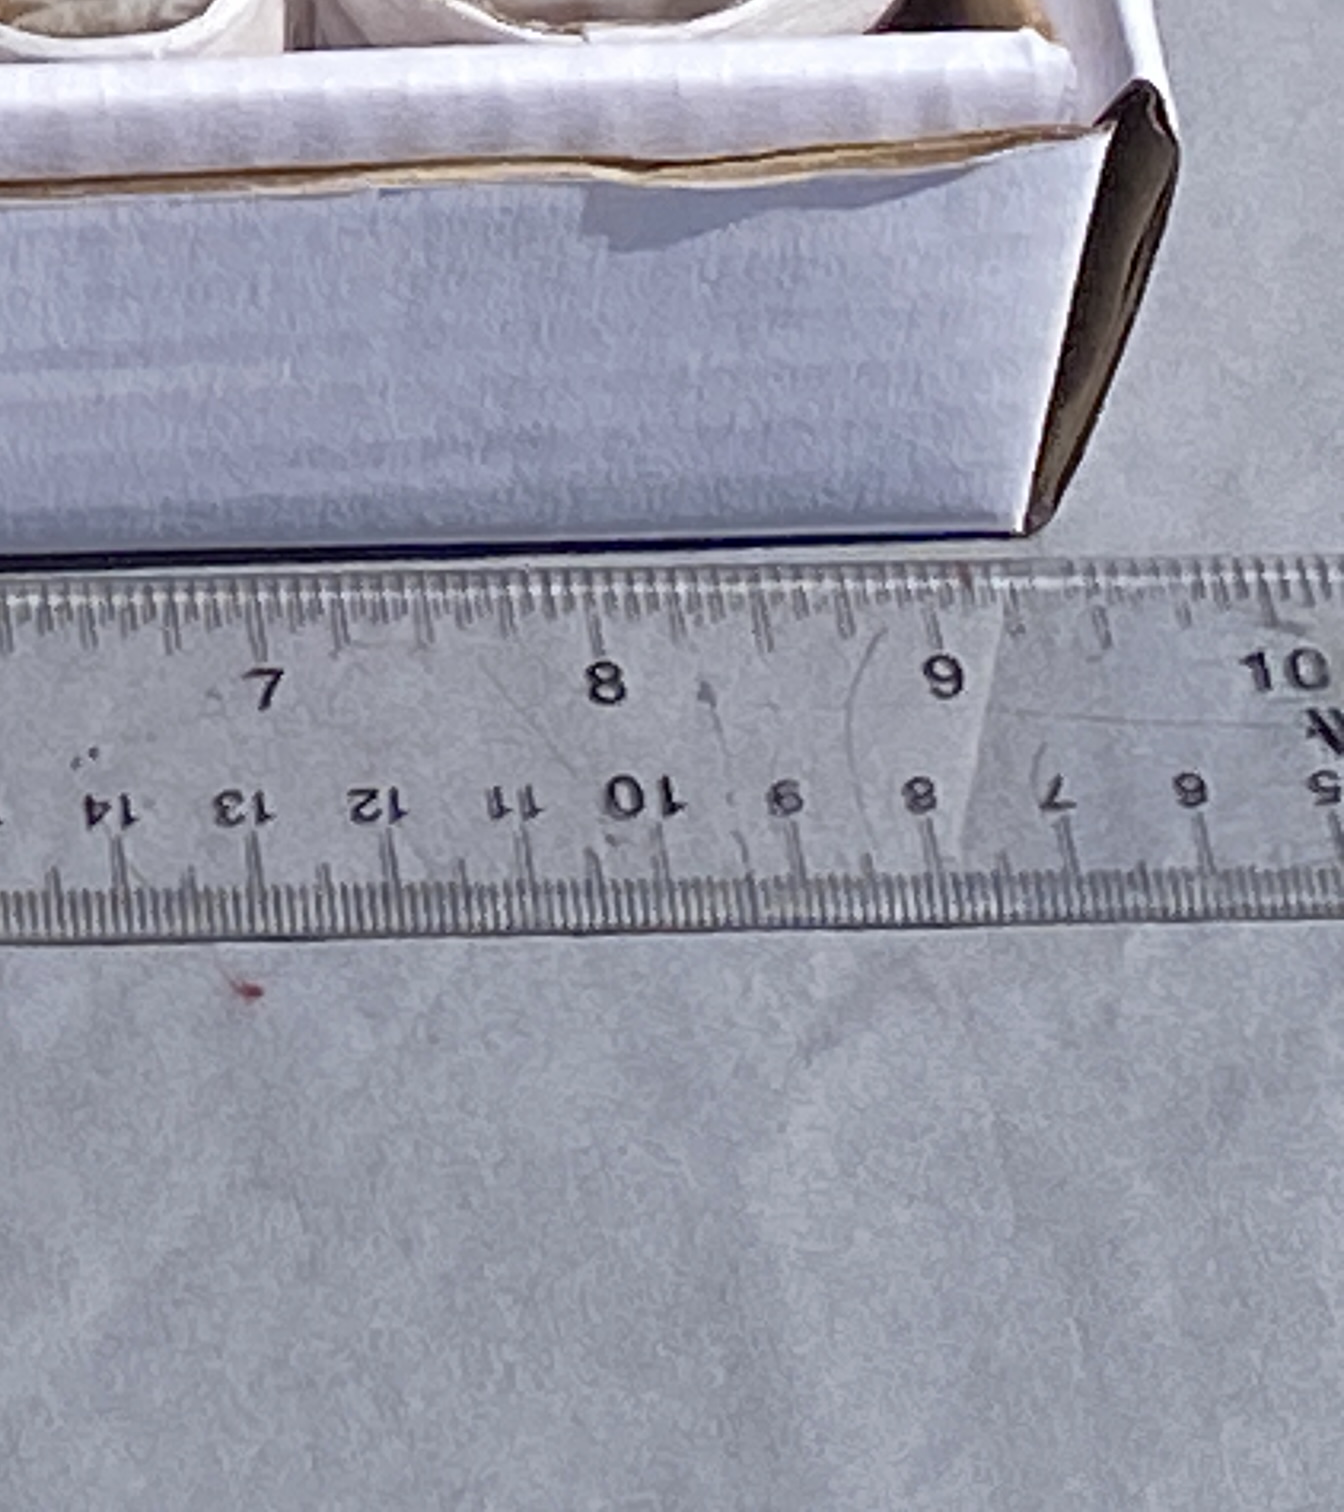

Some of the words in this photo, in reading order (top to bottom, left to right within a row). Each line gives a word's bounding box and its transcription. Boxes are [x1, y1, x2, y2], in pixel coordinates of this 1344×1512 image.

[241, 666, 285, 711] 7
[583, 659, 628, 706] 8
[921, 653, 965, 700] 9
[1238, 647, 1332, 693] 10
[82, 792, 141, 831] 14
[211, 789, 278, 828] 13
[347, 785, 410, 826] 12
[485, 784, 545, 822] 11
[604, 773, 689, 821] 10
[900, 775, 939, 816] 8
[1038, 773, 1078, 812] 7
[1307, 769, 1343, 806] 5
